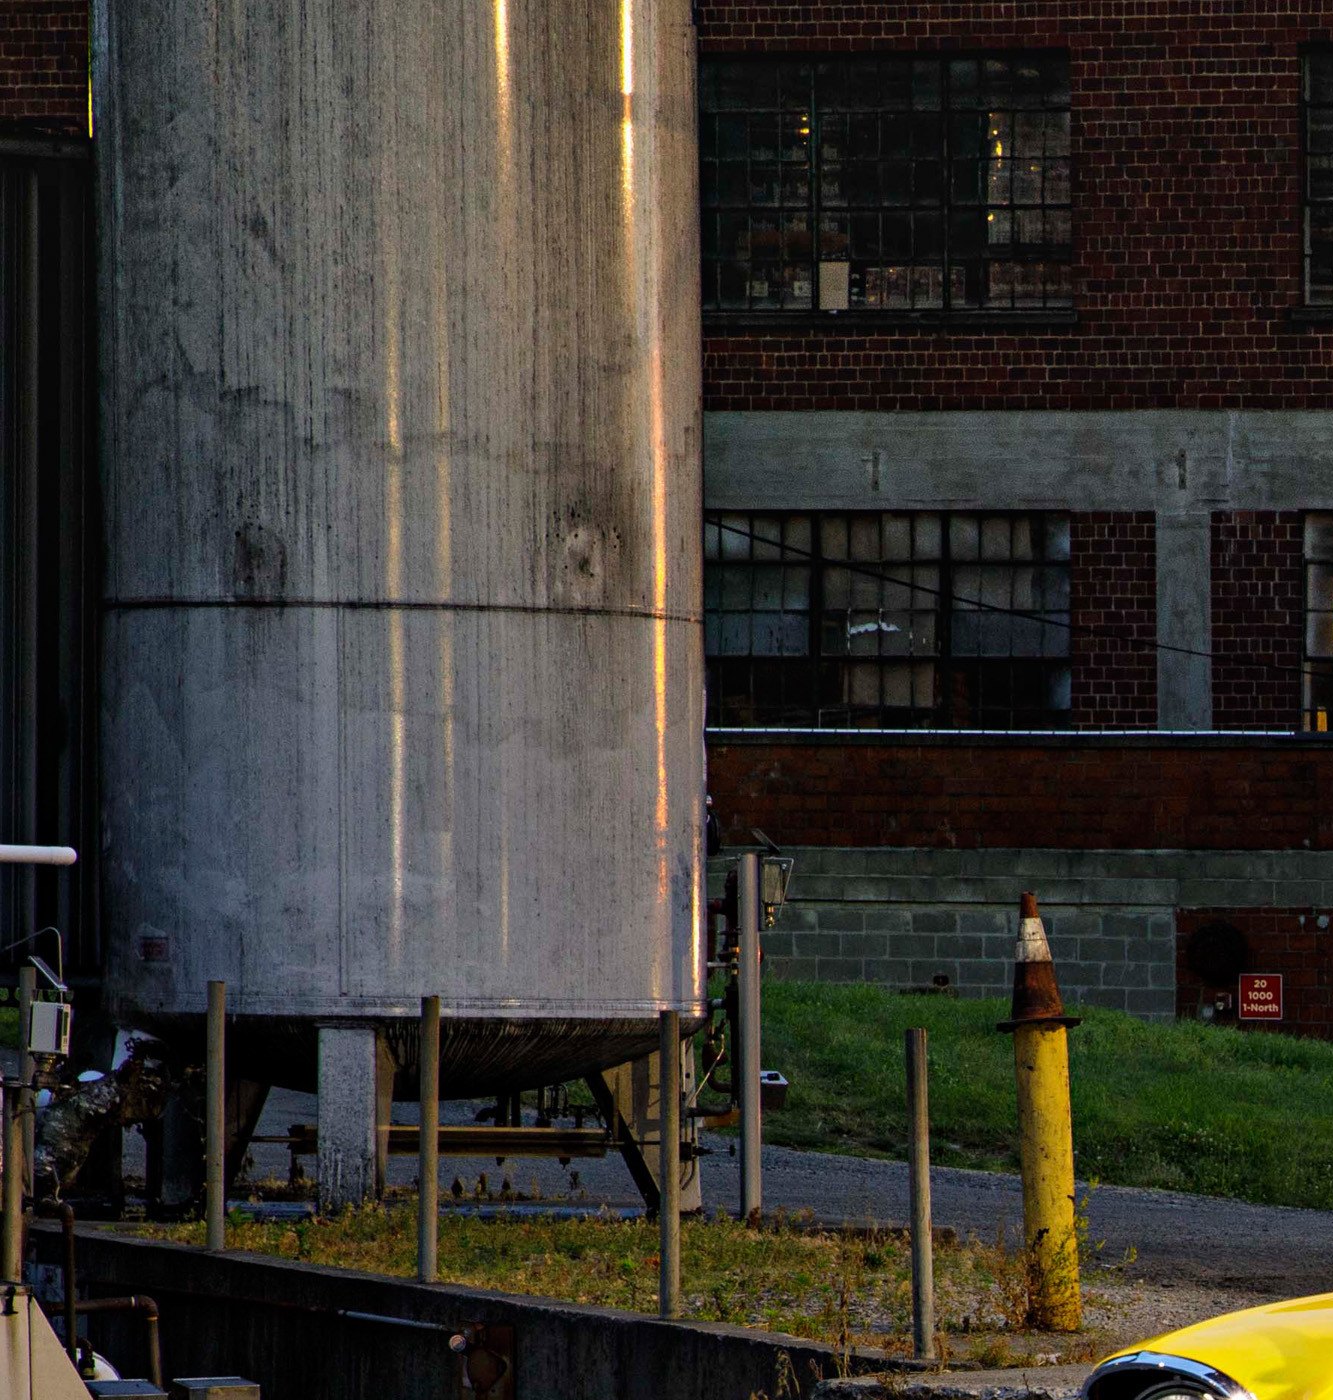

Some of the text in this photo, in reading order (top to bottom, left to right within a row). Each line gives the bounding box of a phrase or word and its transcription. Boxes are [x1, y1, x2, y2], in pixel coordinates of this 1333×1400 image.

[1254, 980, 1267, 988] 20
[1248, 991, 1273, 1000] 1000
[1243, 1003, 1279, 1012] 1-North
